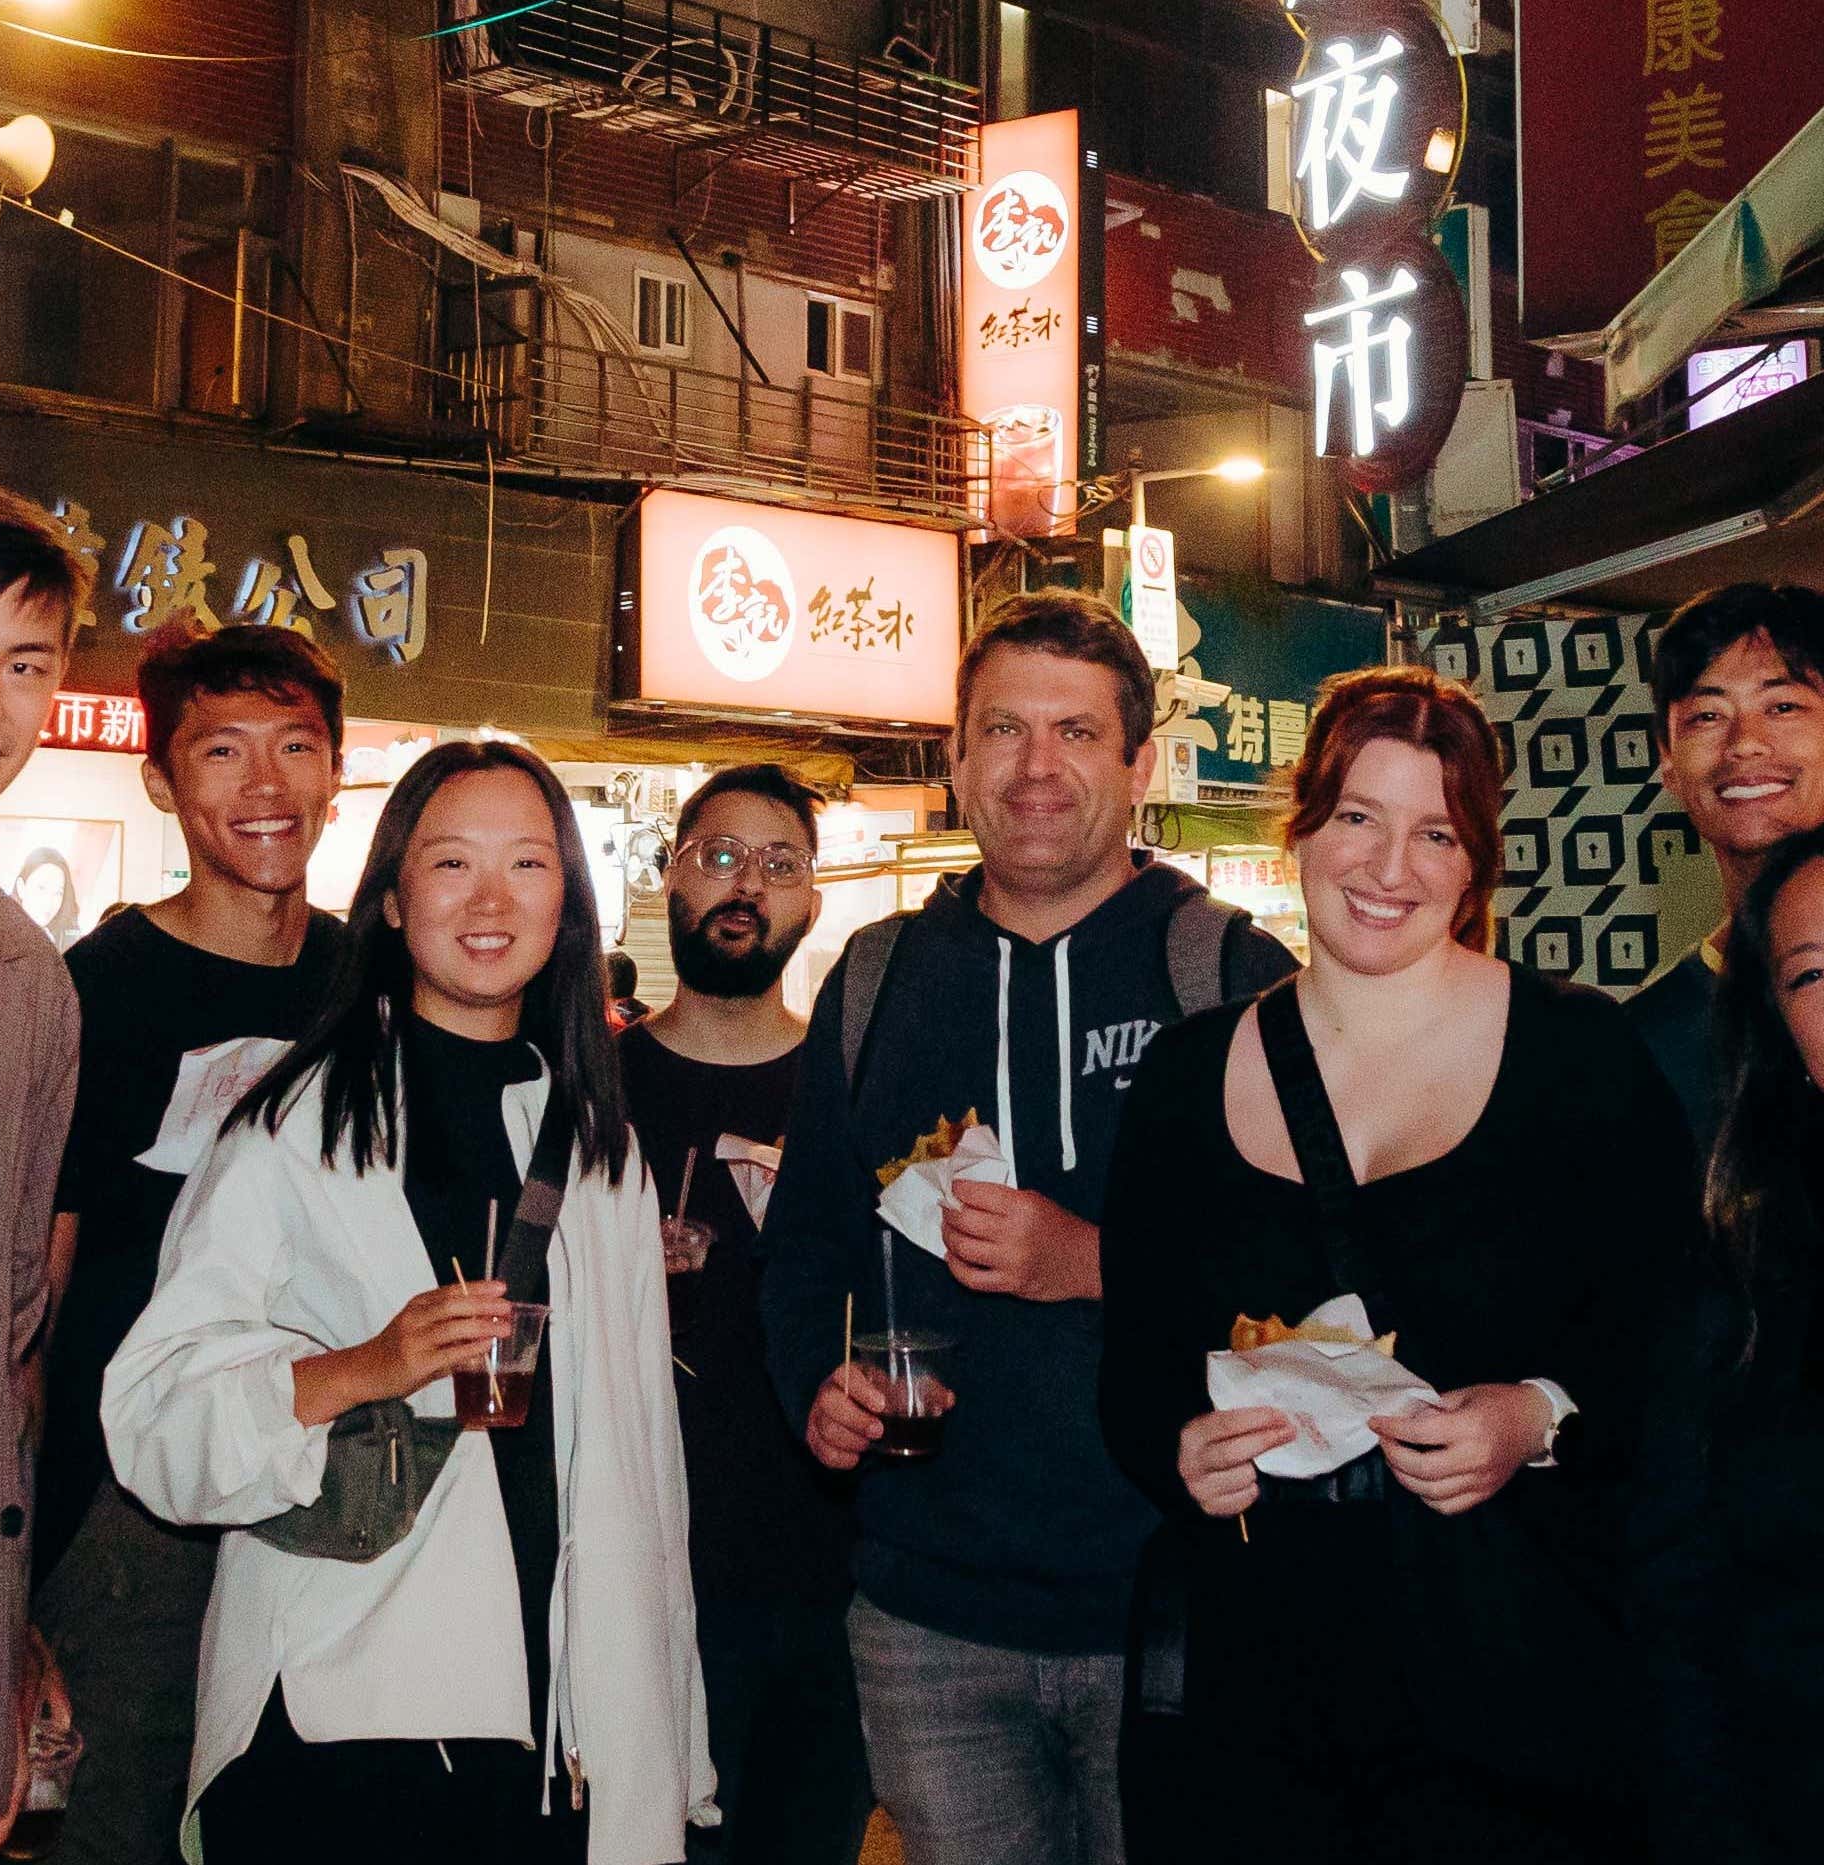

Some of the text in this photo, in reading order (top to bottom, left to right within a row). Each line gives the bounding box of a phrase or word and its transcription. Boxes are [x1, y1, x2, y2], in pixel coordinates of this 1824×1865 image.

[1291, 35, 1418, 458] 夜市
[39, 695, 145, 748] 市新
[1227, 694, 1319, 767] 特賣
[1081, 1020, 1163, 1076] NIK
